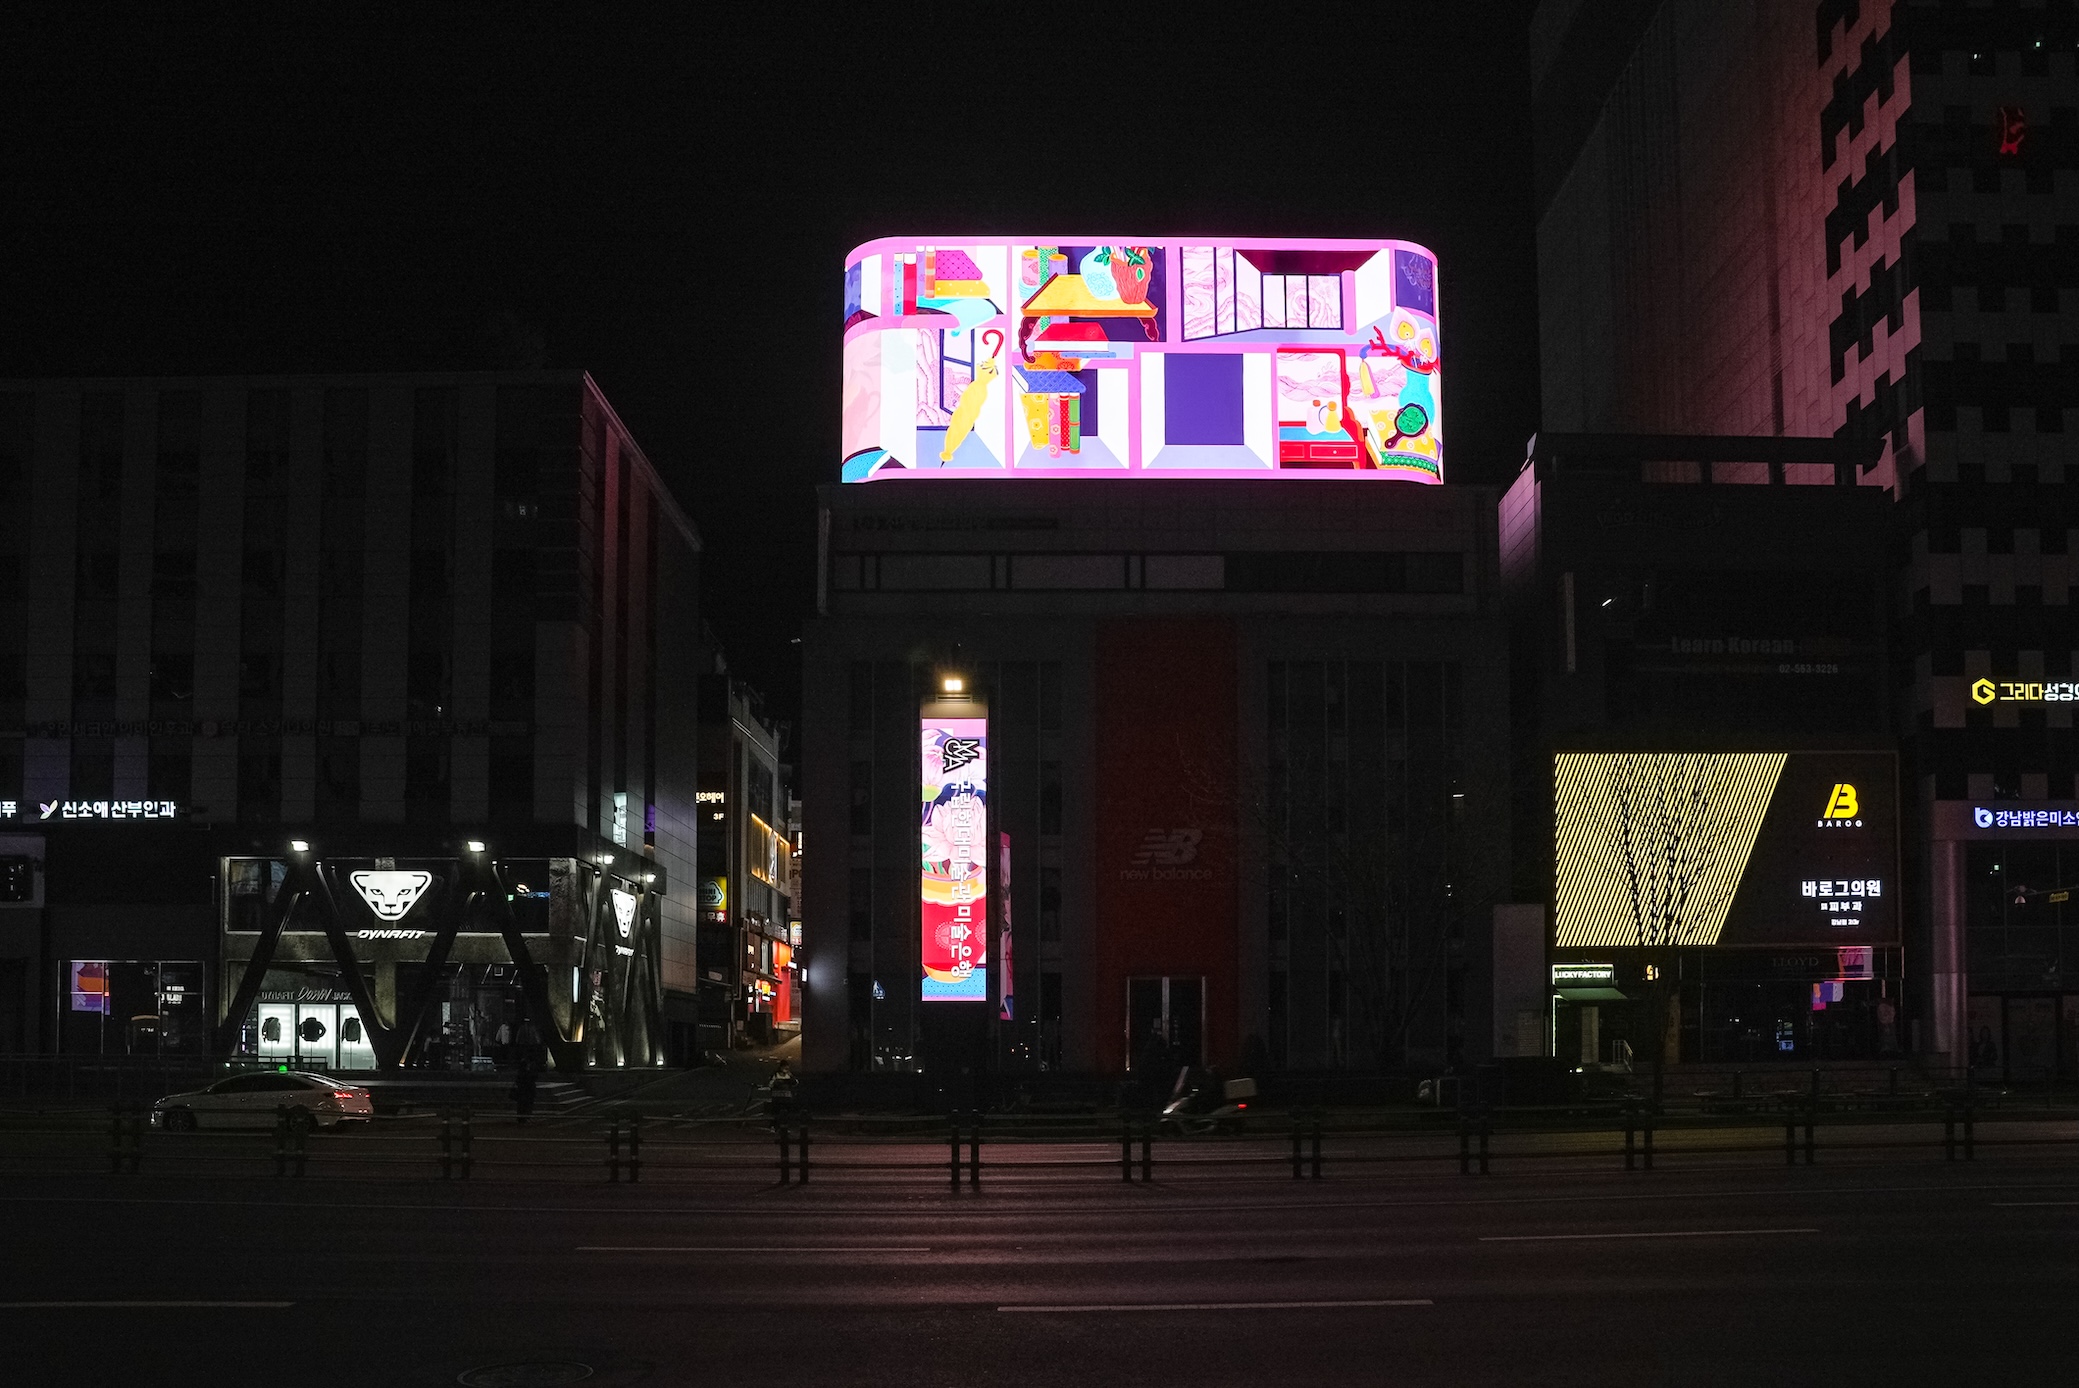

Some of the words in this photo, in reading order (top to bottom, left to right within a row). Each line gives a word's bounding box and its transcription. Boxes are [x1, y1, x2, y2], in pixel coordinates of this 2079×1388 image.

[1671, 637, 1723, 655] Learn
[1728, 637, 1794, 655] Korean
[713, 812, 725, 821] 3F
[950, 776, 972, 903] 국립현대미술관
[1120, 869, 1150, 880] new
[1152, 866, 1213, 880] balance
[1802, 880, 1881, 898] 바로그의원
[358, 929, 426, 940] DYNAFIT
[950, 907, 972, 979] 미술은행
